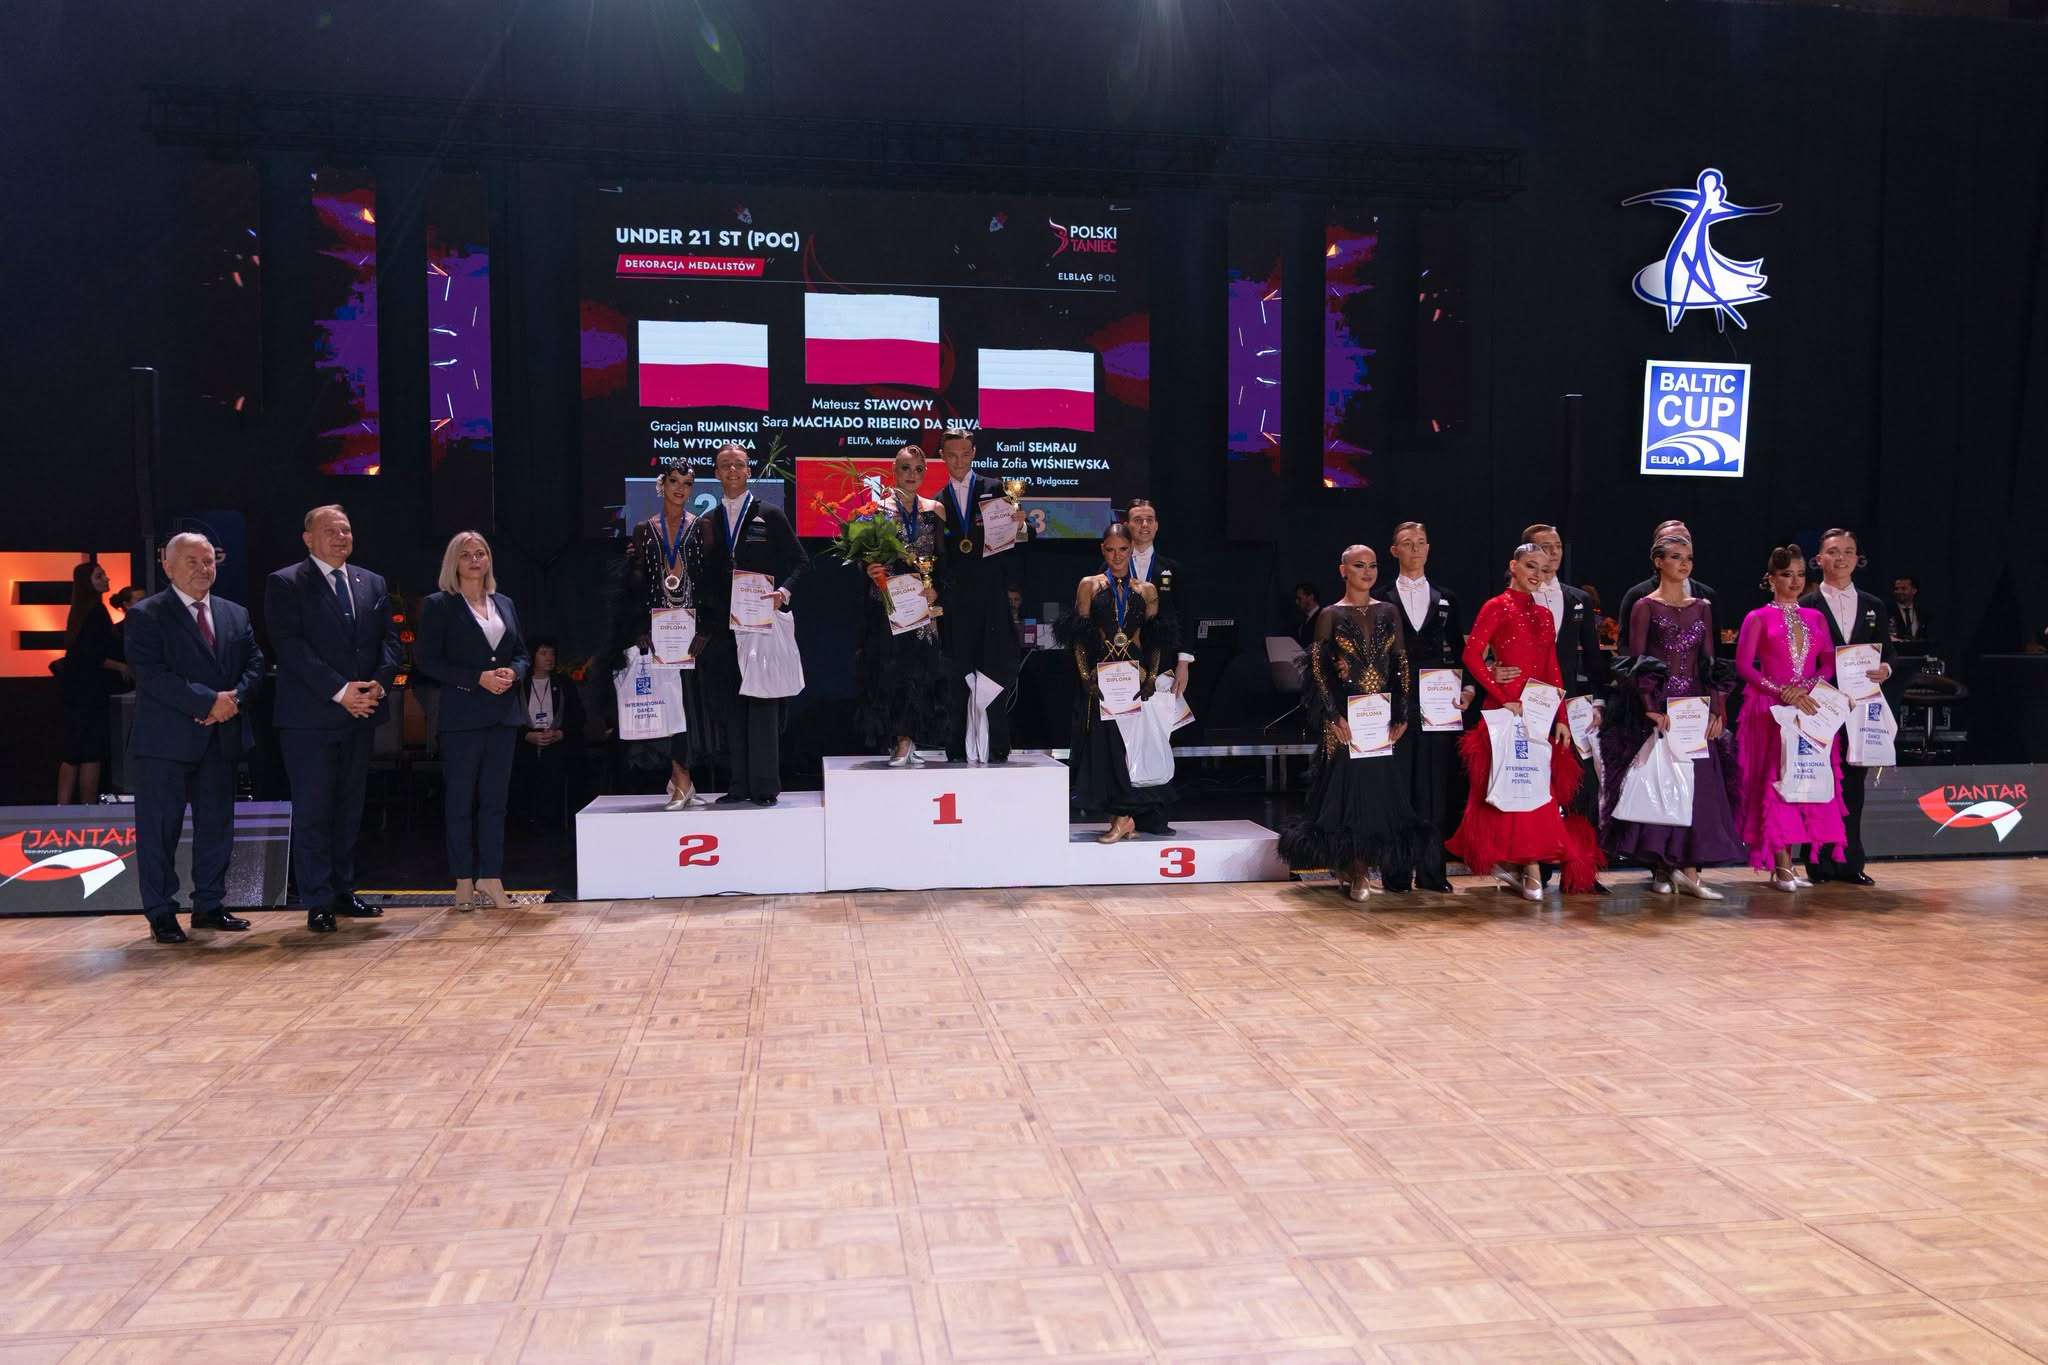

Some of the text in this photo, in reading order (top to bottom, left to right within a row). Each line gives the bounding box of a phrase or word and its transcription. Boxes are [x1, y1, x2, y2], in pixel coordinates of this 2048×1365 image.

[1070, 225, 1117, 239] POLSKI
[616, 227, 800, 252] UNDER 21 ST (POC)
[1071, 239, 1117, 253] TANIEC
[625, 259, 756, 271] DEKORACJA MEDALISTÓW
[1058, 272, 1116, 283] ELBLĄG POL
[1660, 373, 1736, 393] BALTIC
[811, 398, 934, 411] Mateusz STAWOWY
[1657, 394, 1735, 428] CUP
[650, 420, 758, 434] Gracjan RUMINSKI
[762, 416, 982, 430] Sara MACHADO RIBEIRO DA SILVA
[653, 437, 679, 449] Nela
[847, 436, 908, 447] ELITA, Kraków
[996, 441, 1077, 453] Kamil SEMRAU
[971, 456, 1110, 470] melia Zofia WIŚNIEWSKA
[1650, 456, 1685, 466] ELBLĄG
[1036, 476, 1080, 487] Bydgoszcz
[694, 493, 717, 519] 2
[1946, 783, 2029, 800] JANTAR
[933, 793, 962, 824] 1
[679, 835, 719, 866] 2
[1160, 848, 1195, 877] 3
